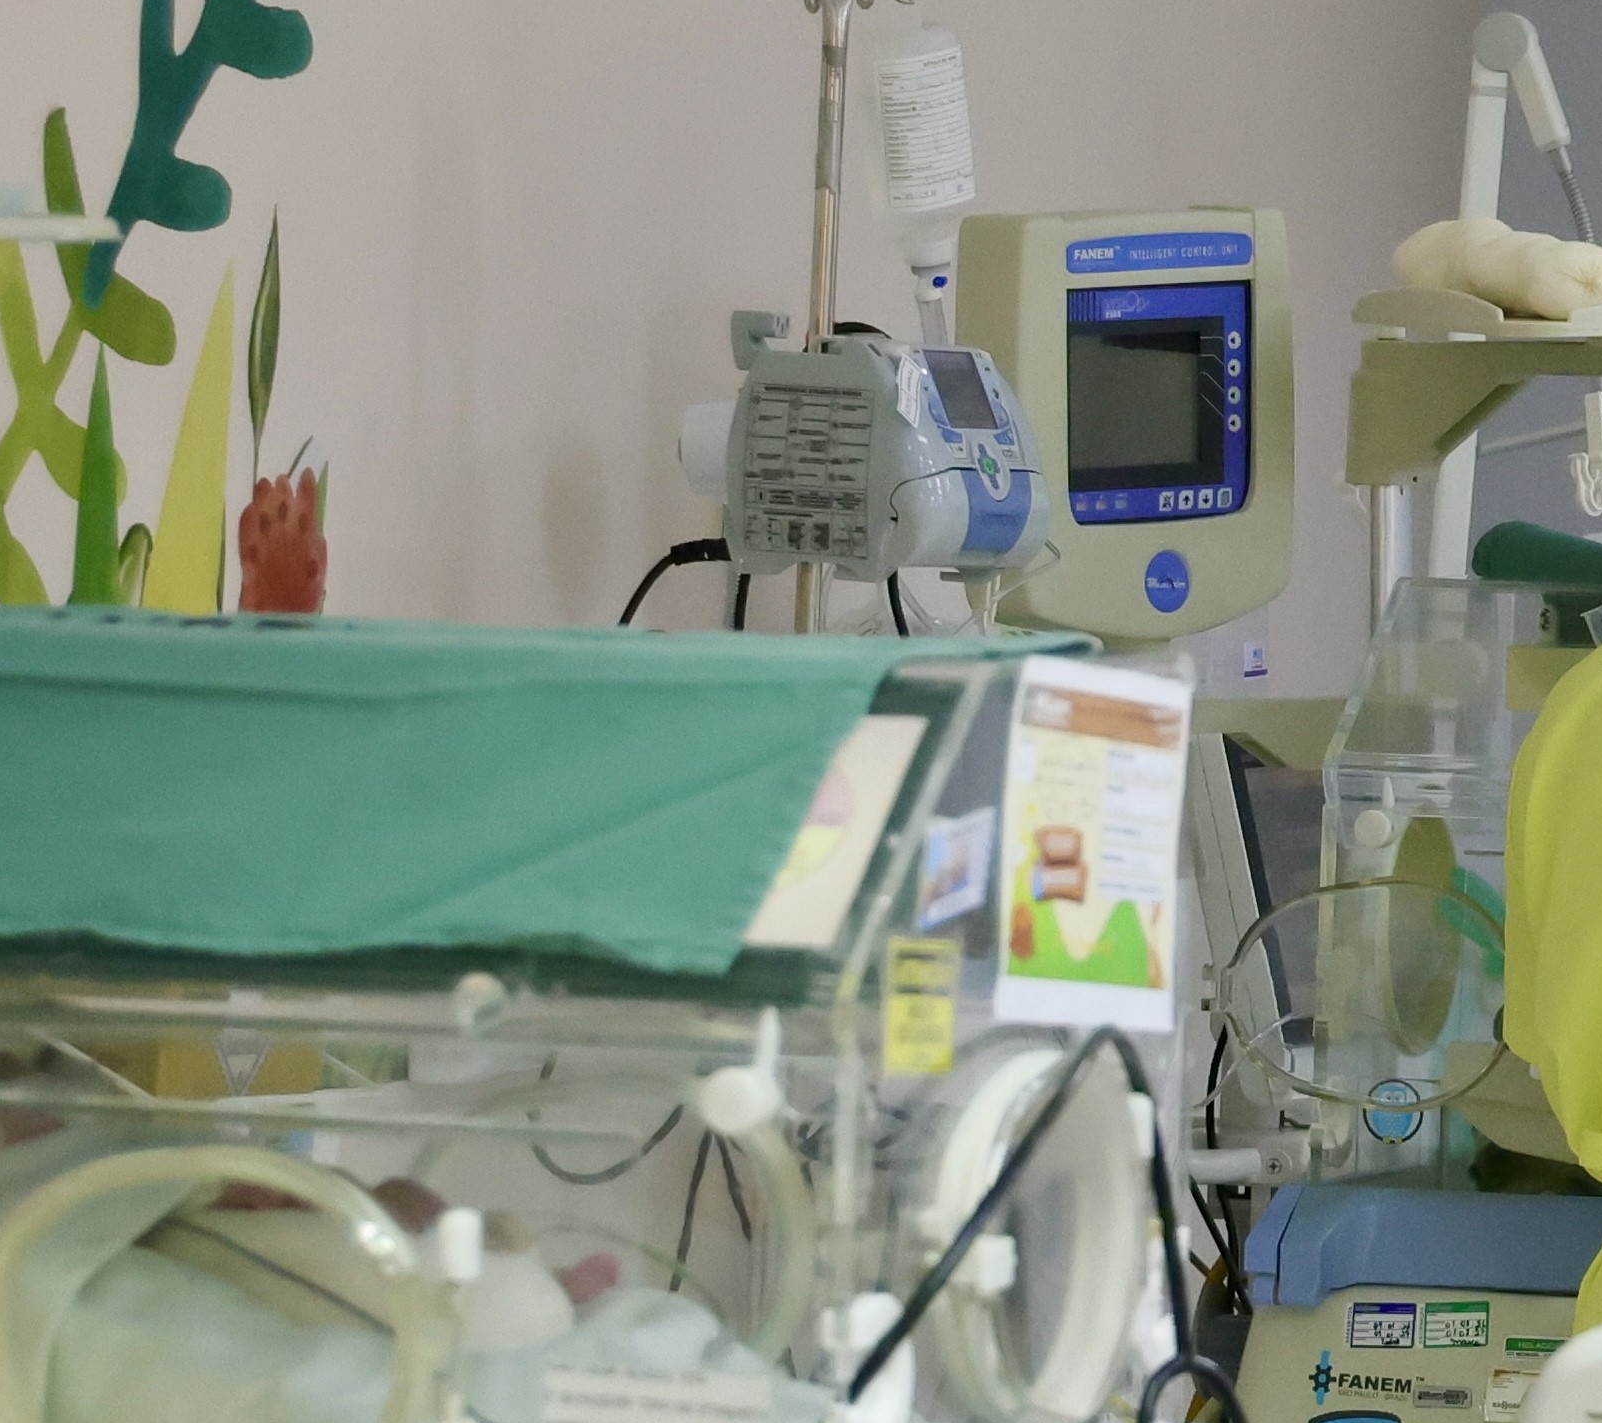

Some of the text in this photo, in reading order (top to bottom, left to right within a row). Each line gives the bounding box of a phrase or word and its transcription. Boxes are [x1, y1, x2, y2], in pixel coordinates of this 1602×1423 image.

[1073, 247, 1115, 261] FANEM
[1129, 249, 1176, 260] INTELLIGENT
[1337, 1373, 1413, 1394] FANEM
